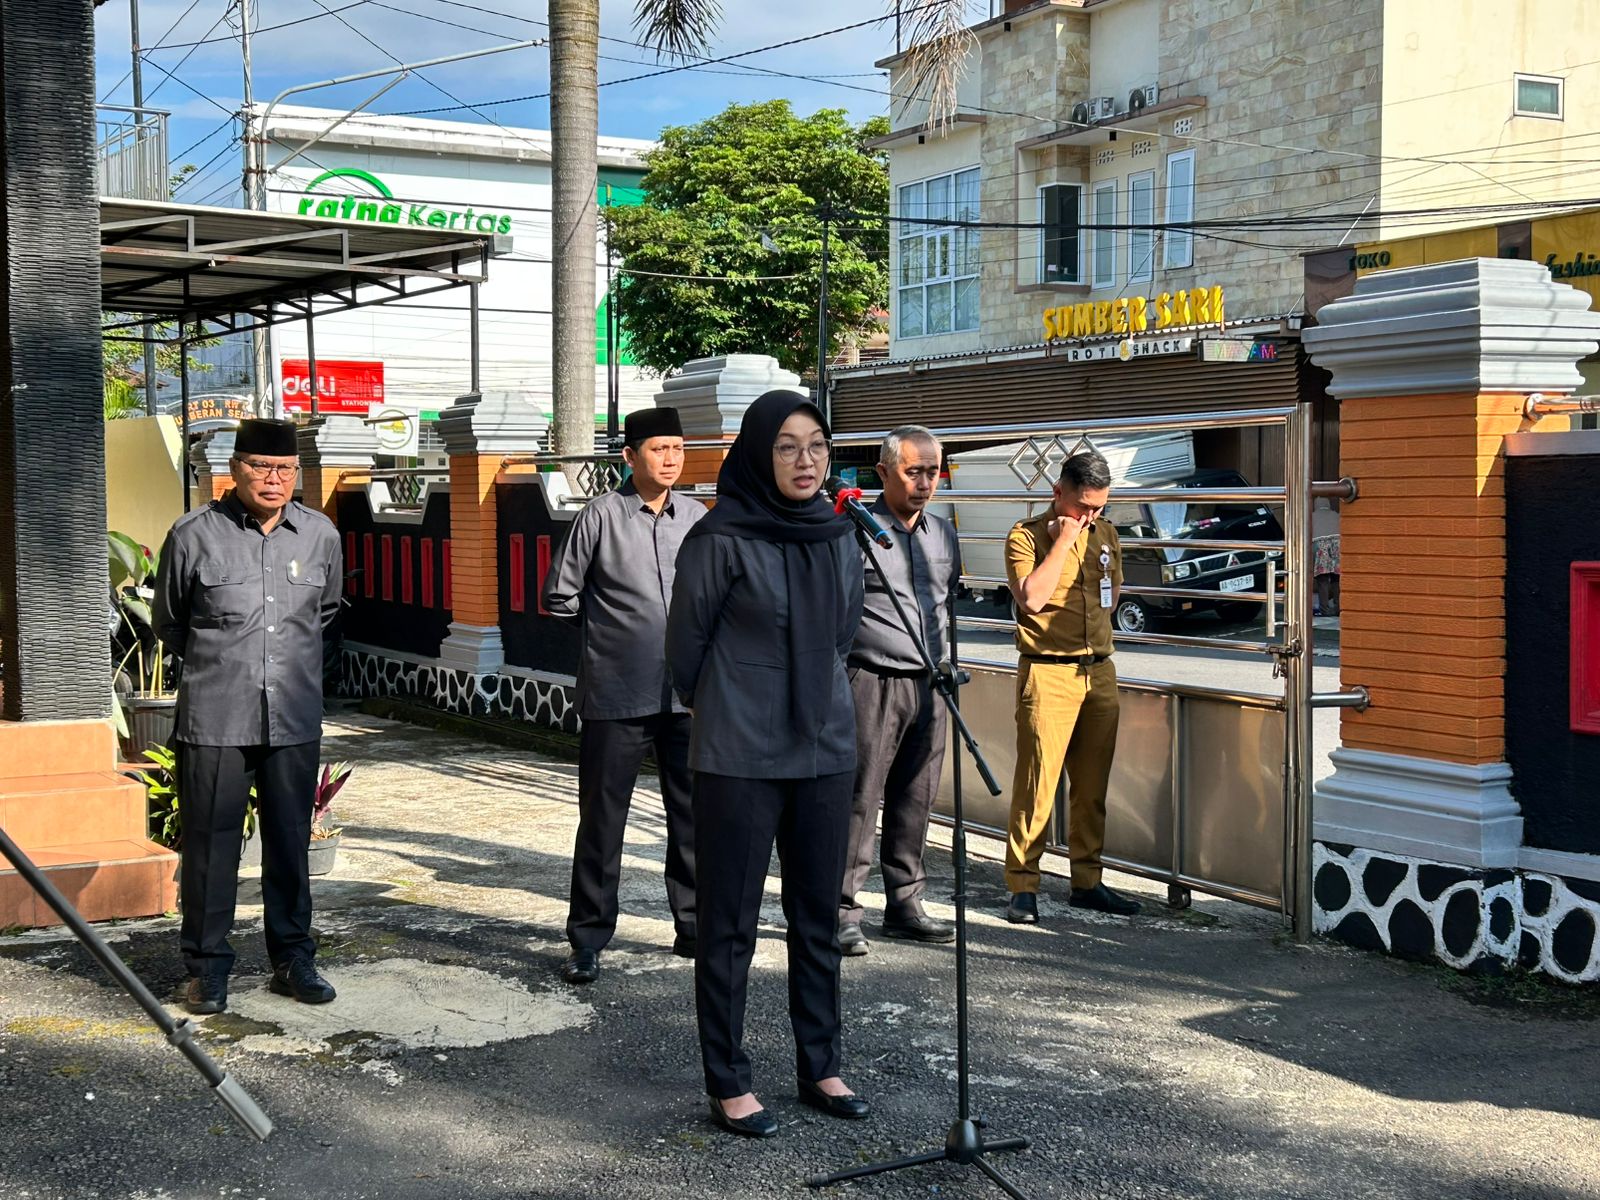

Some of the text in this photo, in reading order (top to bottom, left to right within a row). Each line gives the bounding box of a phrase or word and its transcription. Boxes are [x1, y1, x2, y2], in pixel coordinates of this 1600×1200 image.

[407, 203, 512, 235] Kertas
[1042, 285, 1224, 340] SUMBER SARI
[1072, 346, 1115, 361] ROTI
